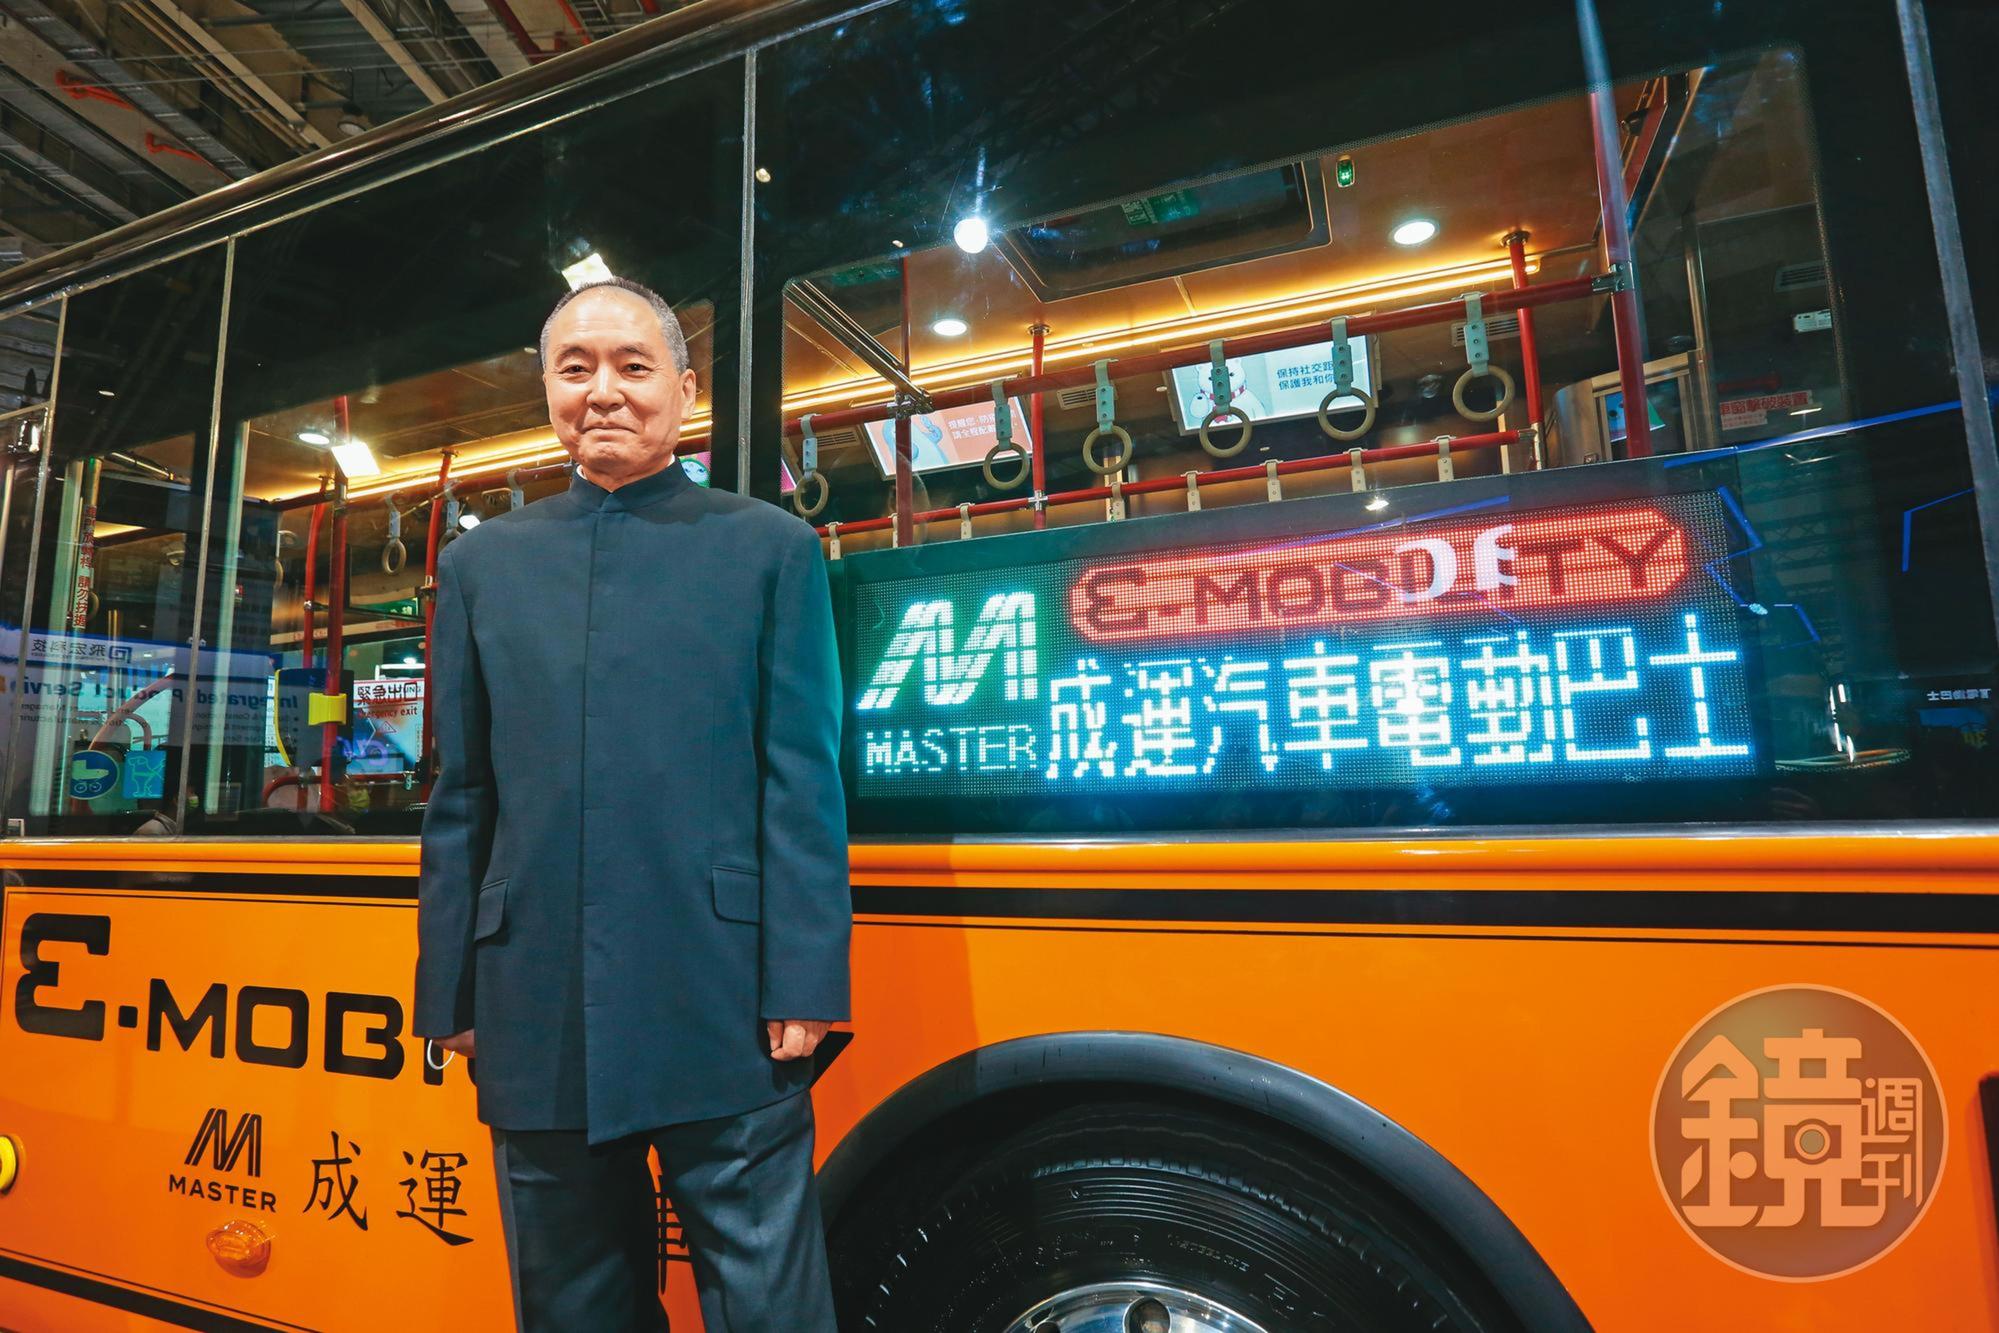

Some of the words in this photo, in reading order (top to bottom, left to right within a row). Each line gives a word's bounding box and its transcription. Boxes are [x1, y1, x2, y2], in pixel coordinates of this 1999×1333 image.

[357, 682, 418, 706] 緊急出口
[400, 706, 418, 716] exit
[1046, 614, 1750, 779] 成運汽車電動巴士
[866, 724, 1037, 774] MASTER
[169, 1174, 277, 1213] MASTER
